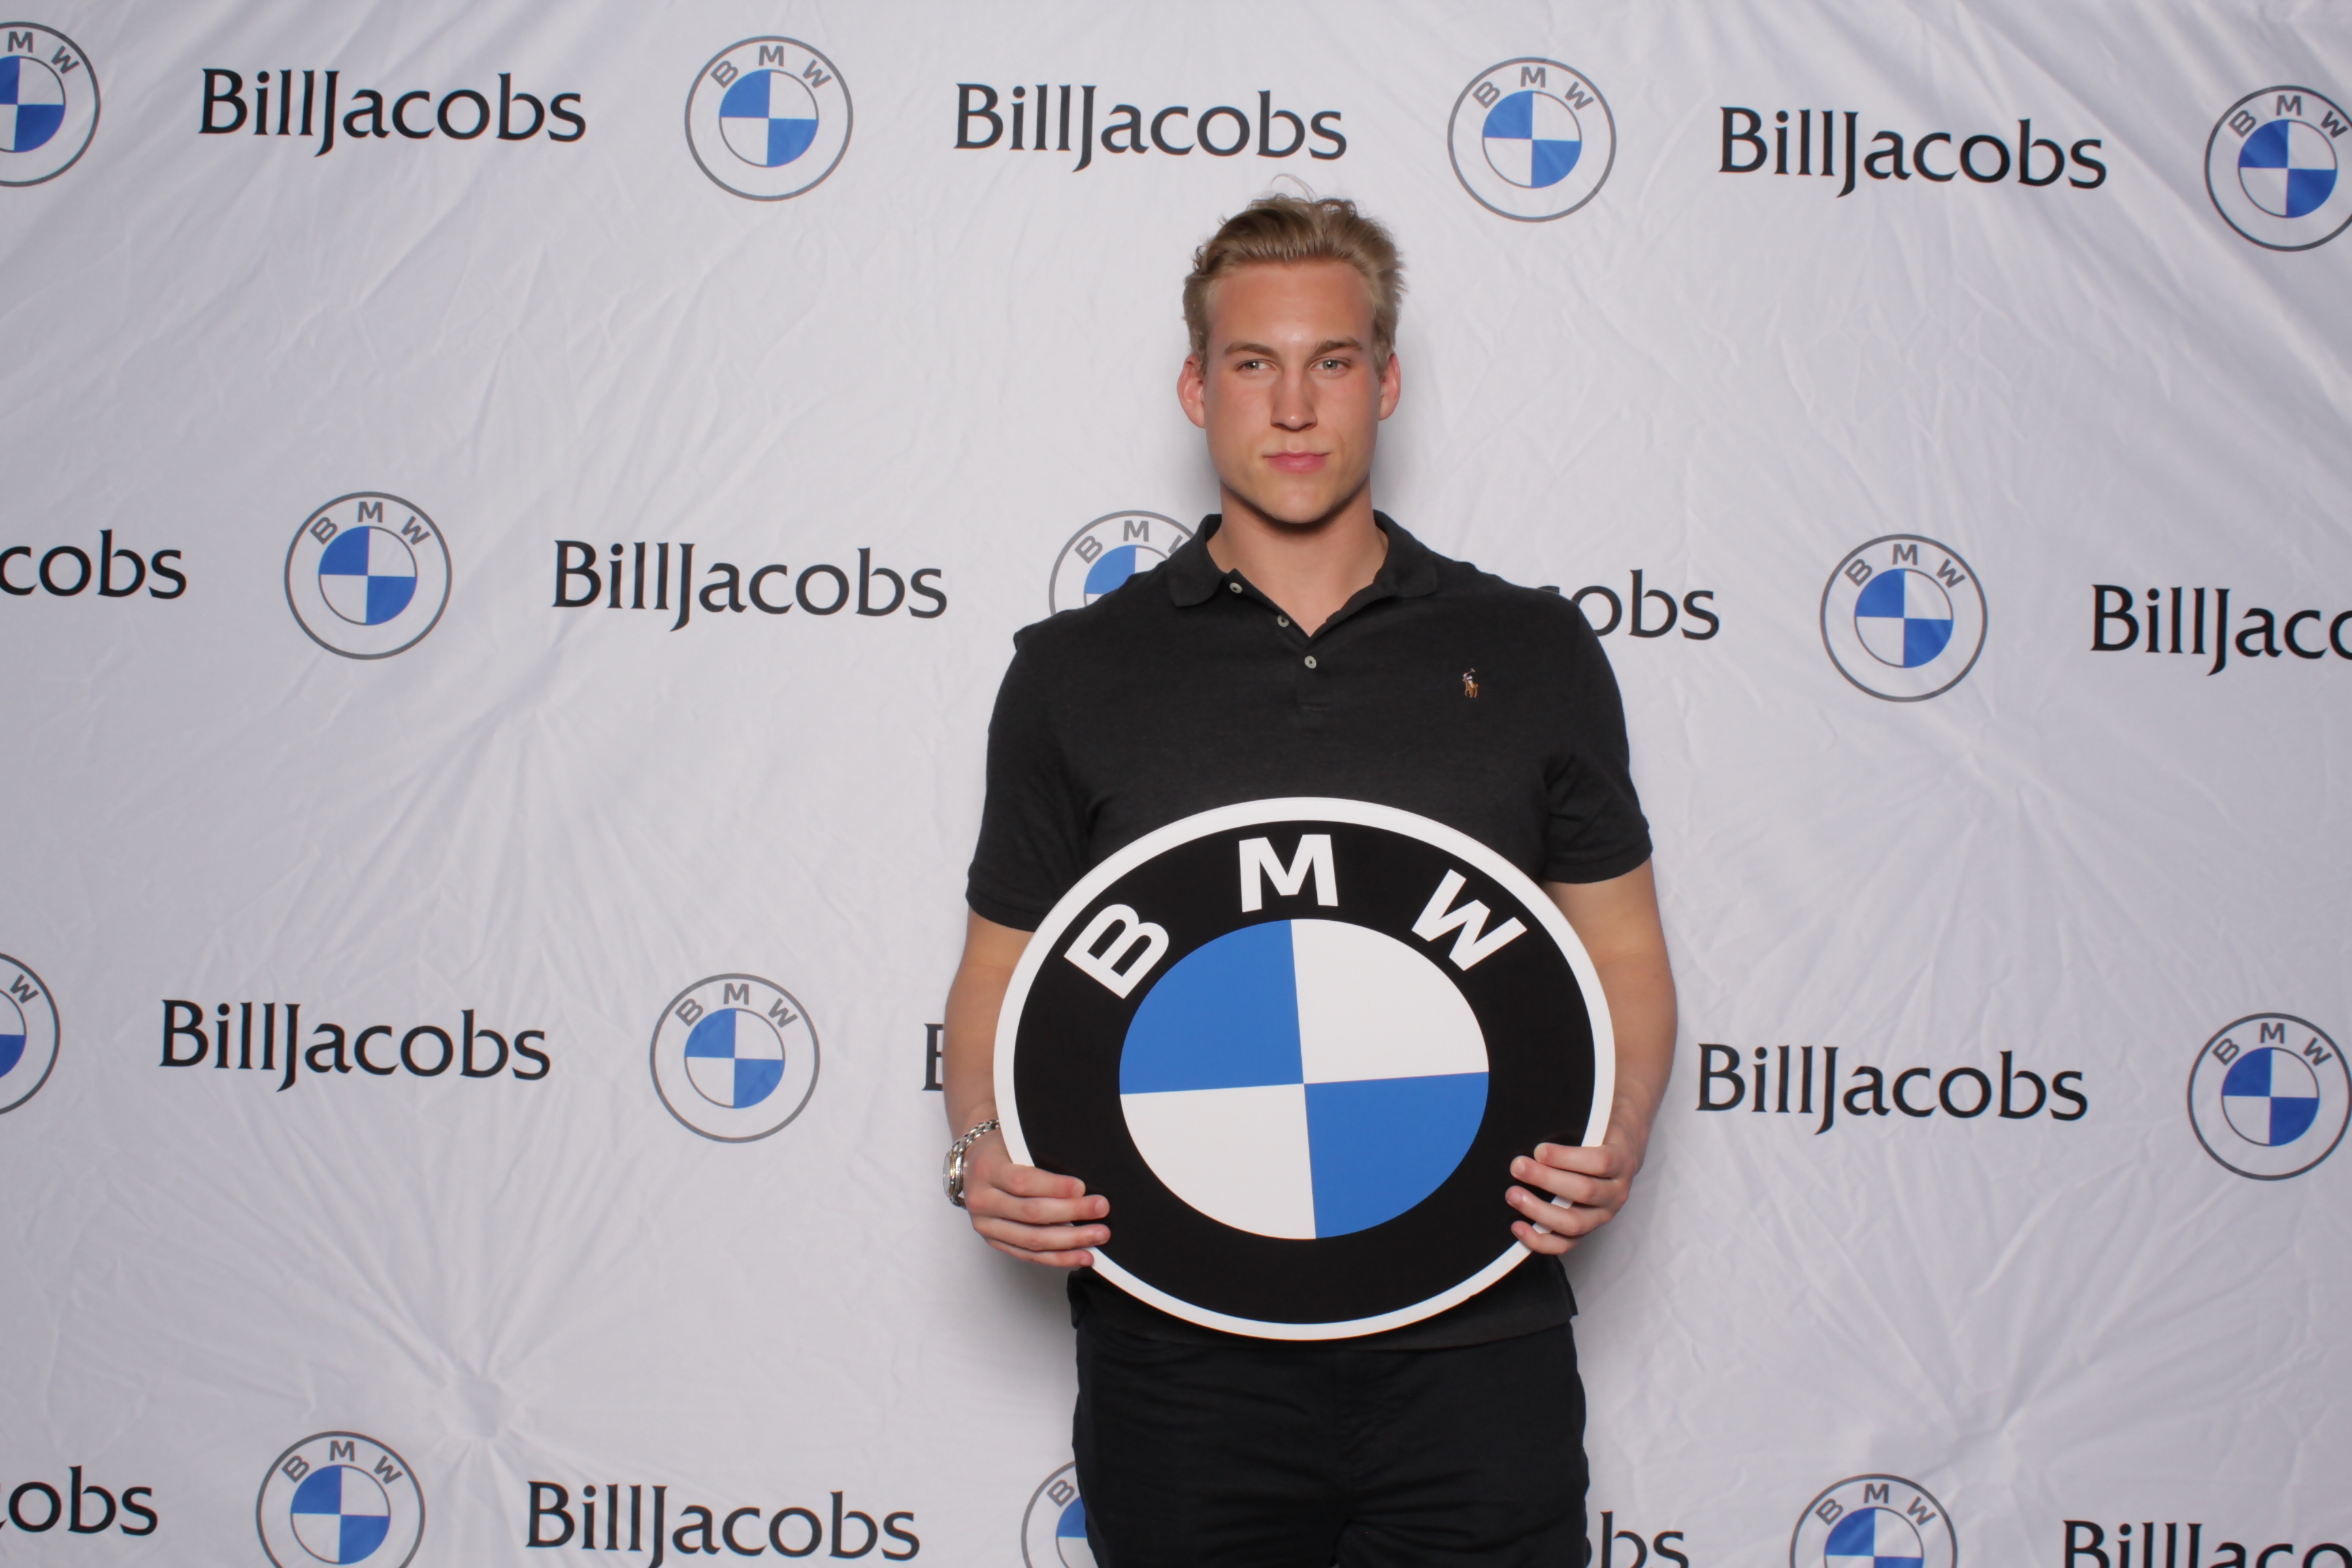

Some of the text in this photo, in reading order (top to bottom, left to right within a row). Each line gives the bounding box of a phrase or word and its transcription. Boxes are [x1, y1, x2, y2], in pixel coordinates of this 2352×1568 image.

[710, 46, 831, 88] BMW
[1473, 67, 1594, 110] BMW
[197, 67, 587, 158] BillJacobs
[954, 83, 1348, 172] BillJacobs
[2228, 95, 2349, 139] BMW
[1718, 106, 2108, 198] BillJacobs
[310, 501, 431, 545] BMW
[551, 540, 948, 632] BillJacobs
[1844, 544, 1966, 588] BMW
[1537, 568, 1720, 641] obs
[1064, 834, 1528, 999] BMW
[675, 983, 798, 1028] BMW
[159, 999, 551, 1092] BillJacobs
[2211, 1022, 2333, 1066] BMW
[1695, 1043, 2089, 1136] BillJacobs
[281, 1440, 403, 1484] BMW
[0, 1465, 159, 1537] obs
[1815, 1483, 1936, 1526] BMW
